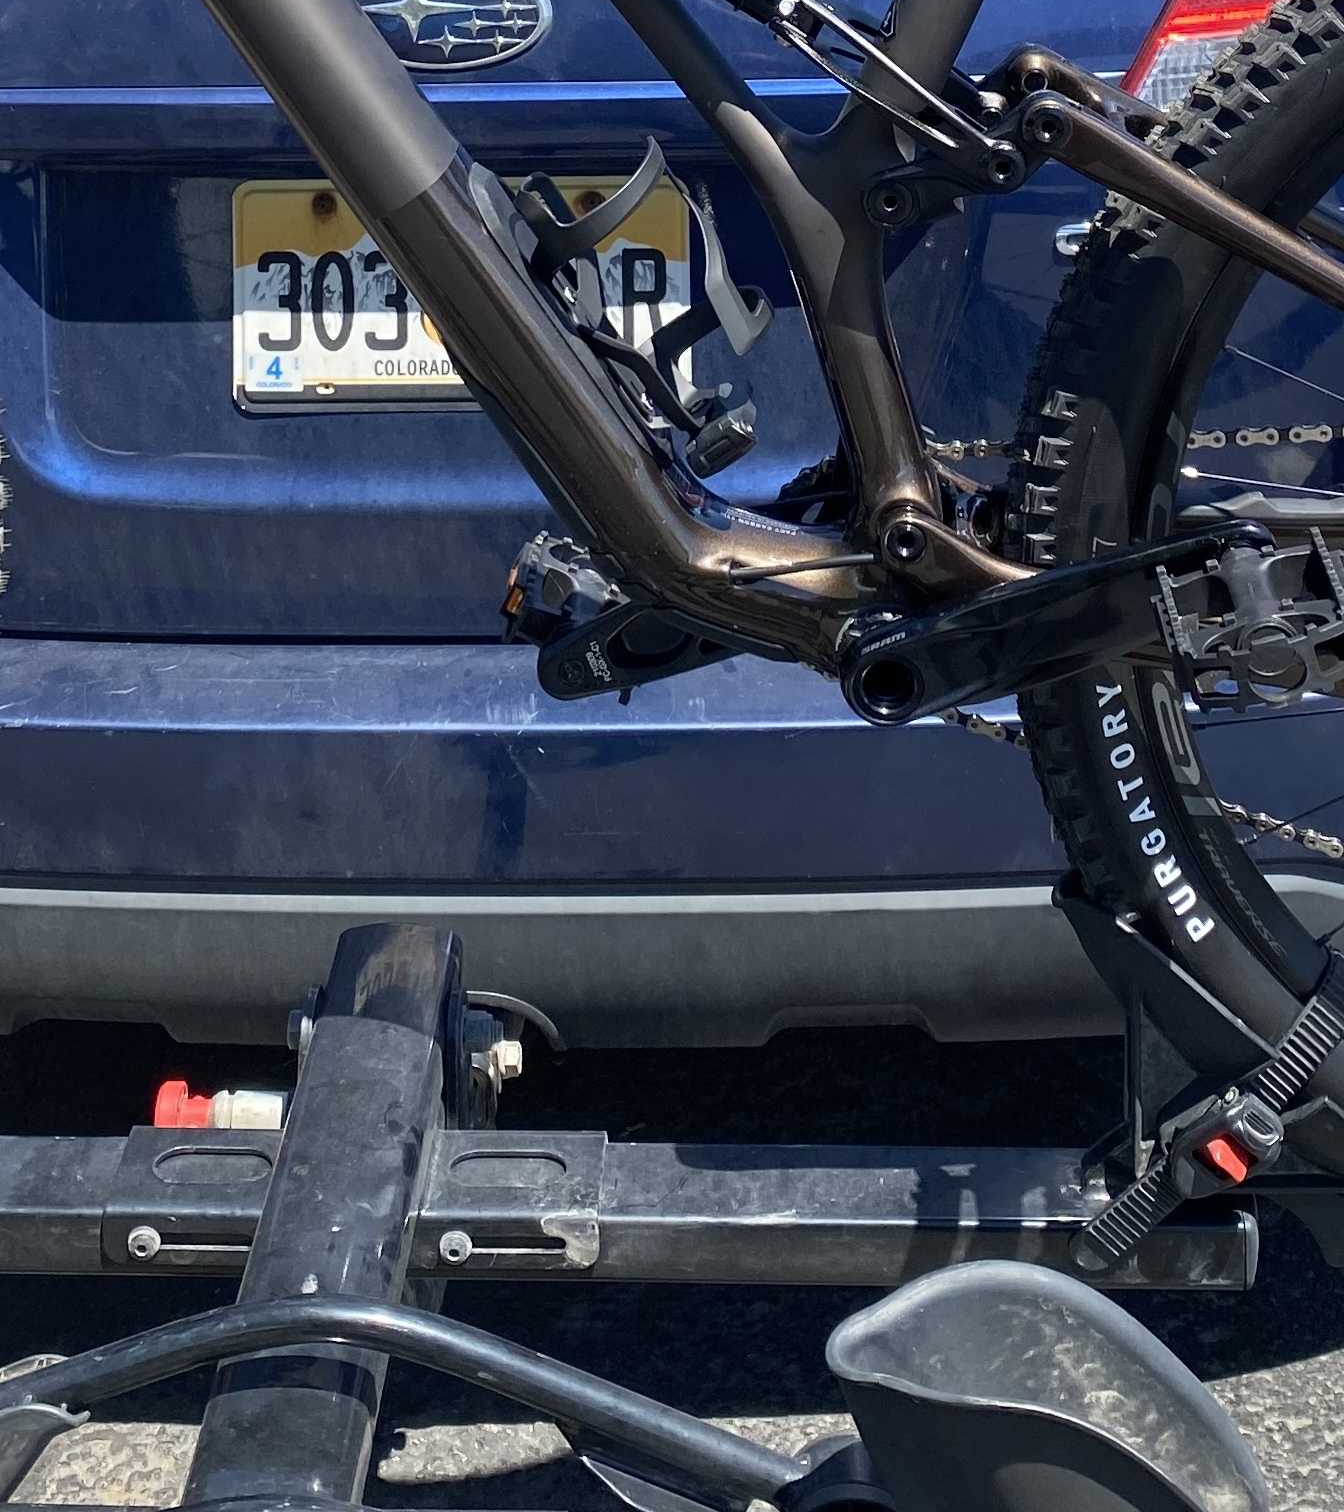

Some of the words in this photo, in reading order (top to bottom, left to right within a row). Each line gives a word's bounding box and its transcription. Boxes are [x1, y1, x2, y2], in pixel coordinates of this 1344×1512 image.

[257, 250, 411, 352] 303
[266, 355, 284, 380] 4
[1095, 683, 1216, 943] PURGATORY
